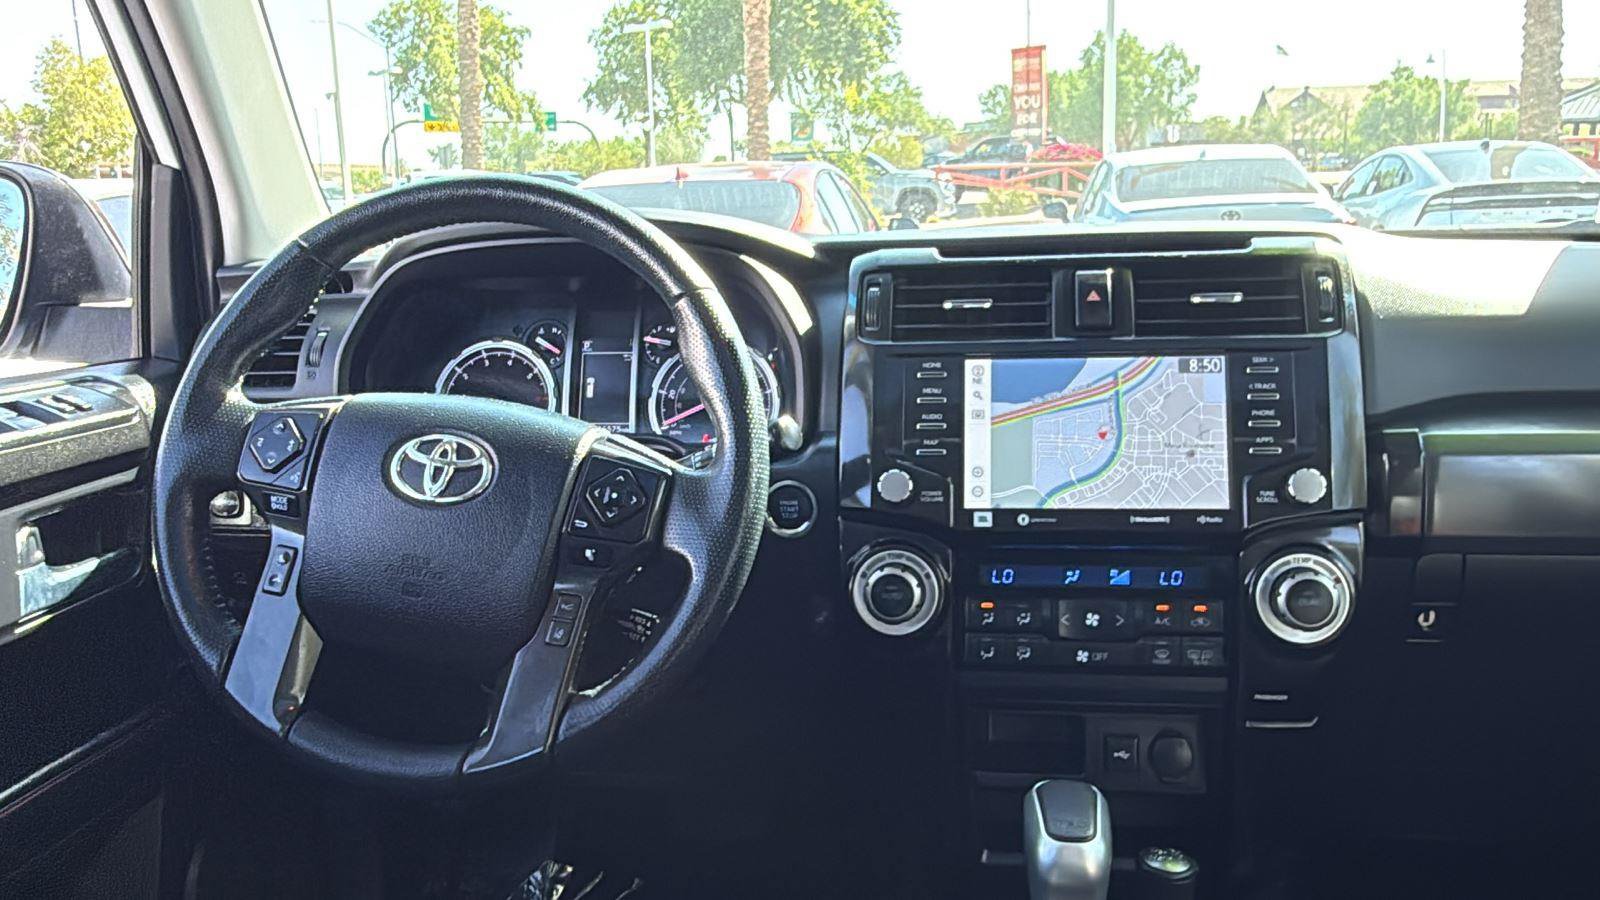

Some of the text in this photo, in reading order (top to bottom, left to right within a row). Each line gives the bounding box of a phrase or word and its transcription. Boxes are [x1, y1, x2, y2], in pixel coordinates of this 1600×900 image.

[1013, 94, 1041, 110] YOU
[1189, 358, 1221, 372] 8:50
[668, 389, 677, 399] 20
[270, 495, 288, 503] MODE
[1292, 556, 1312, 564] TEMP
[991, 568, 1015, 584] LO
[1158, 570, 1184, 586] LO
[1154, 616, 1171, 626] A/C
[1091, 652, 1109, 661] OFF
